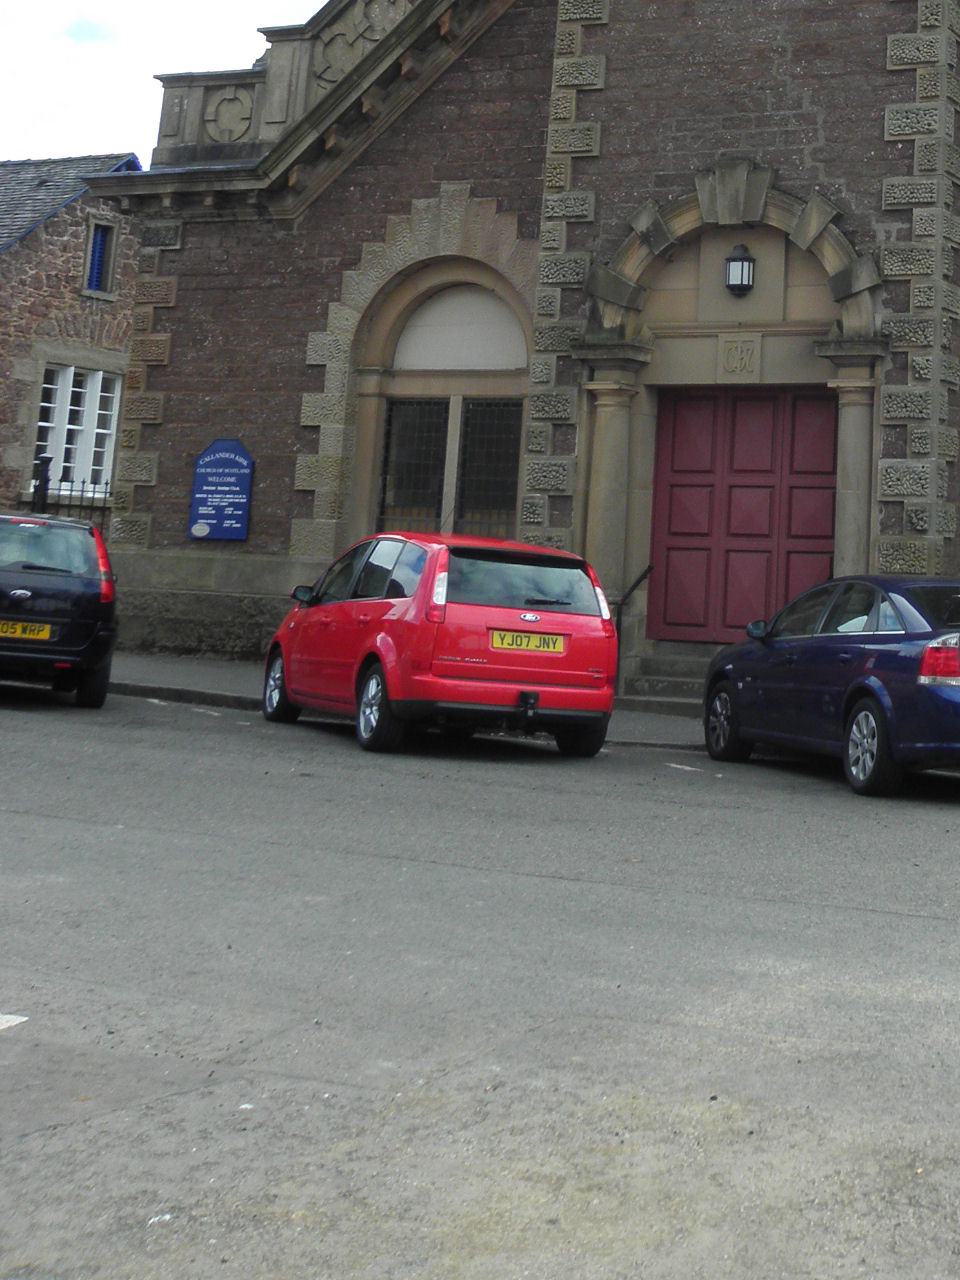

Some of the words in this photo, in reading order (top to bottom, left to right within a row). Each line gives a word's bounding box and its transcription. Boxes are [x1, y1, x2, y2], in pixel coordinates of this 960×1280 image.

[199, 452, 235, 465] CALLANDER
[21, 623, 45, 636] WRP
[498, 633, 531, 648] YJ07
[534, 636, 559, 650] JNY
